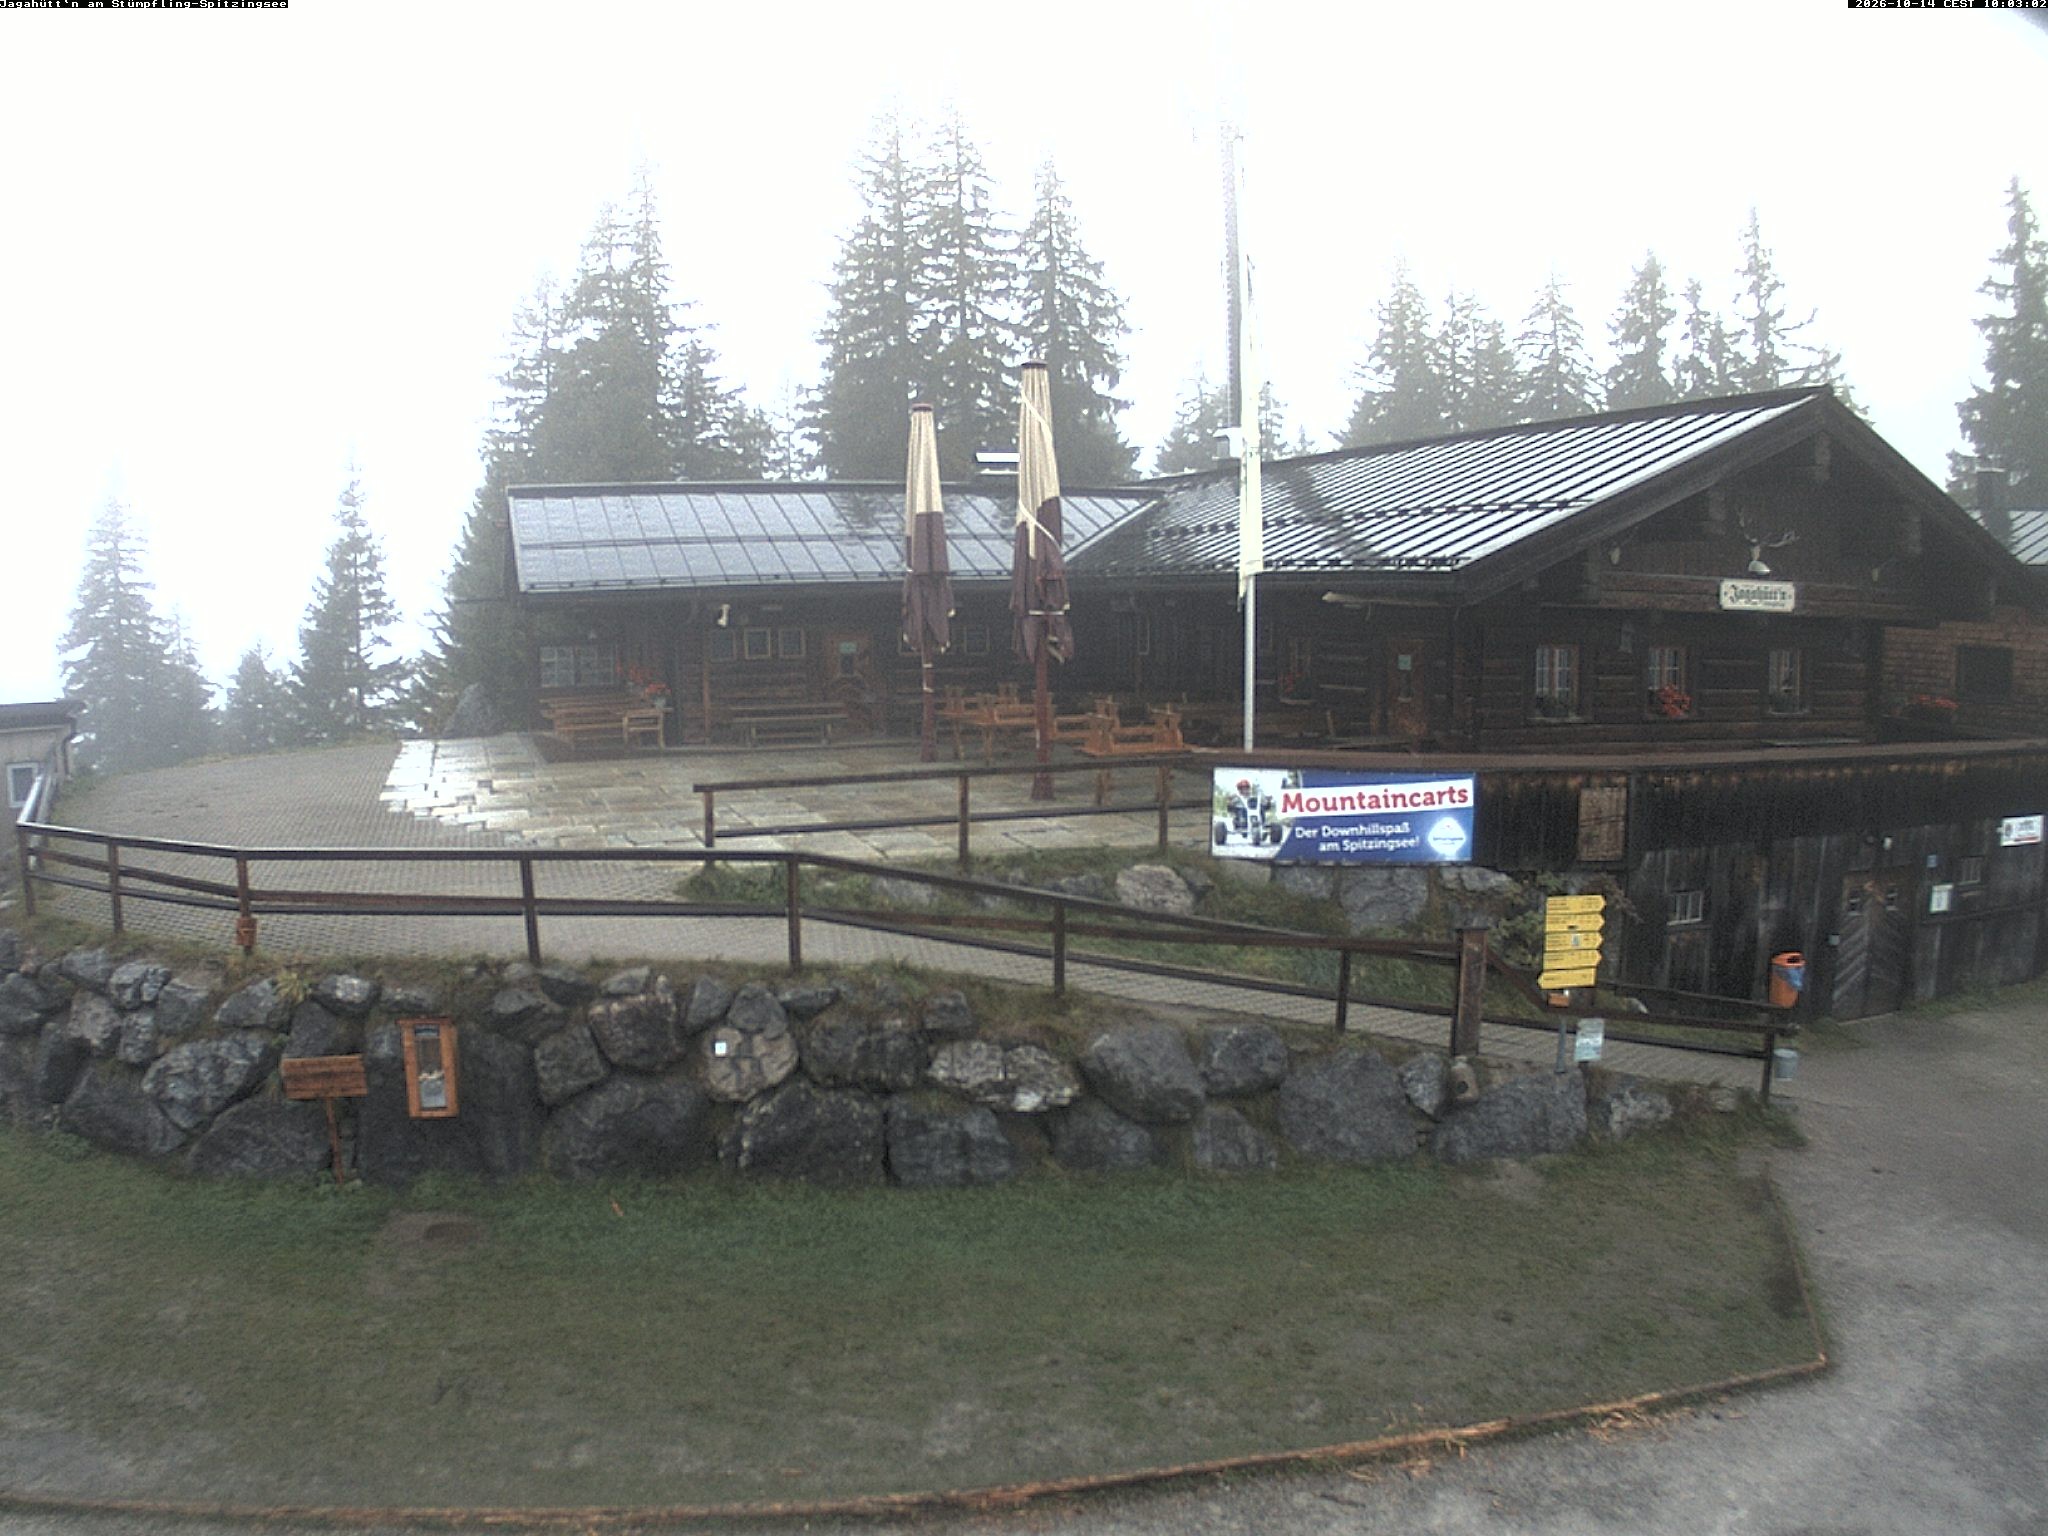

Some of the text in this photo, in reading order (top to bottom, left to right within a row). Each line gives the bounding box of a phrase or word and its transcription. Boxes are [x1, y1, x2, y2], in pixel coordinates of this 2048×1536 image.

[1282, 786, 1469, 813] Mountaincarts
[1295, 822, 1411, 839] Der Downhillspaß
[1319, 836, 1420, 853] am Spitzingsee!
